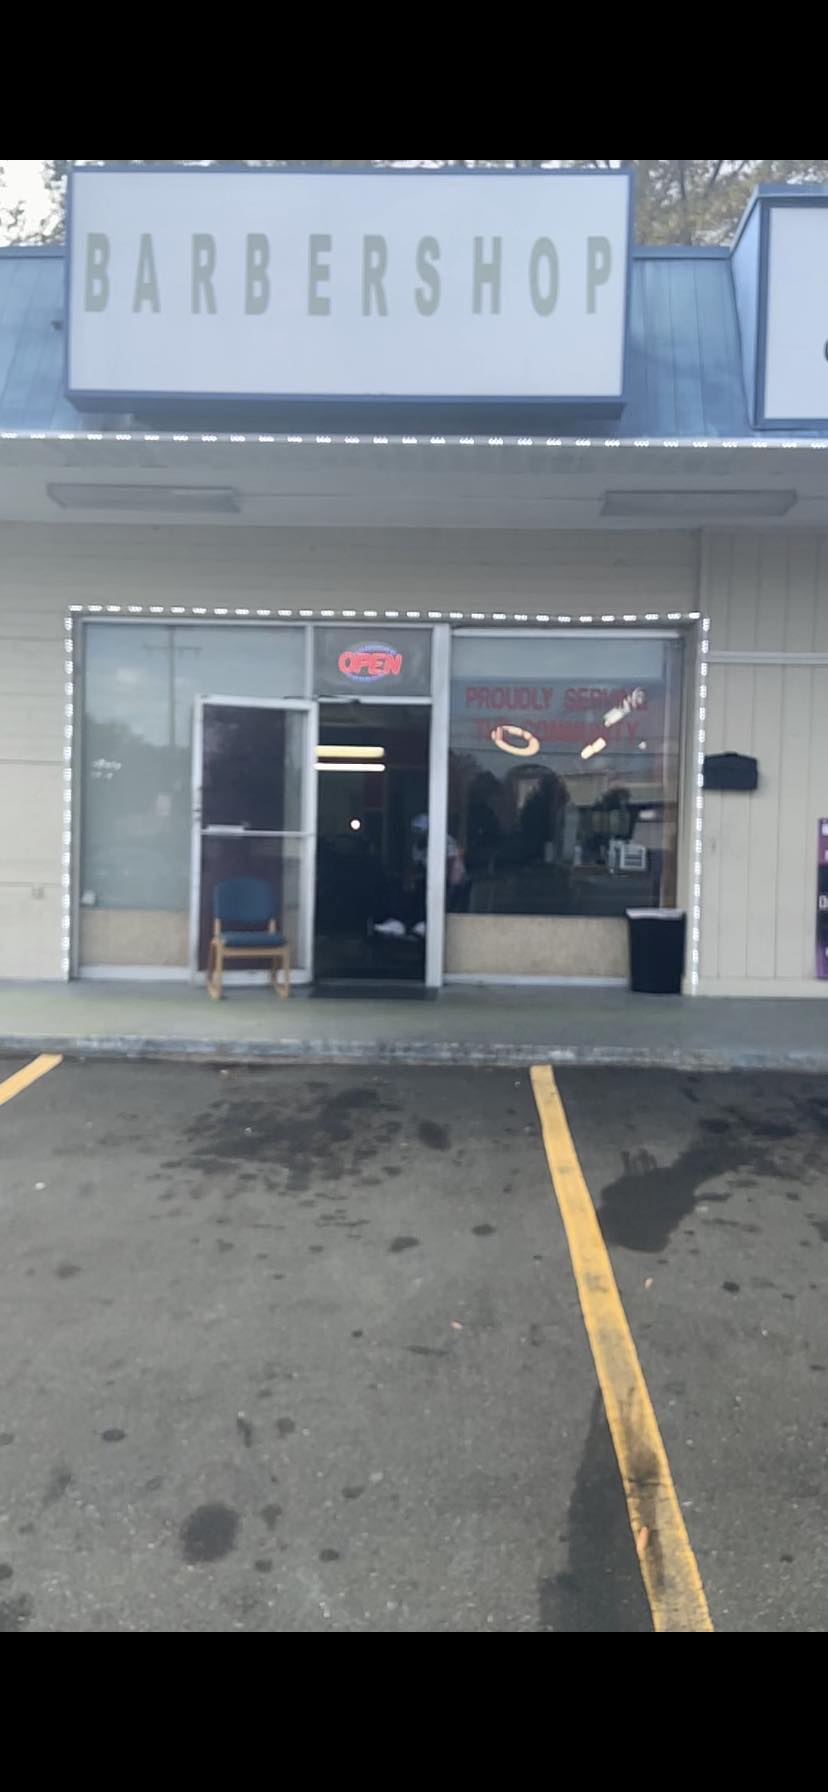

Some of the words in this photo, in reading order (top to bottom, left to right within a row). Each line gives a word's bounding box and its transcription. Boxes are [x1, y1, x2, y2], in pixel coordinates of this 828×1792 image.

[84, 232, 613, 317] BARBERSHOP
[338, 651, 403, 676] OPEN
[465, 687, 553, 710] PROUDLY
